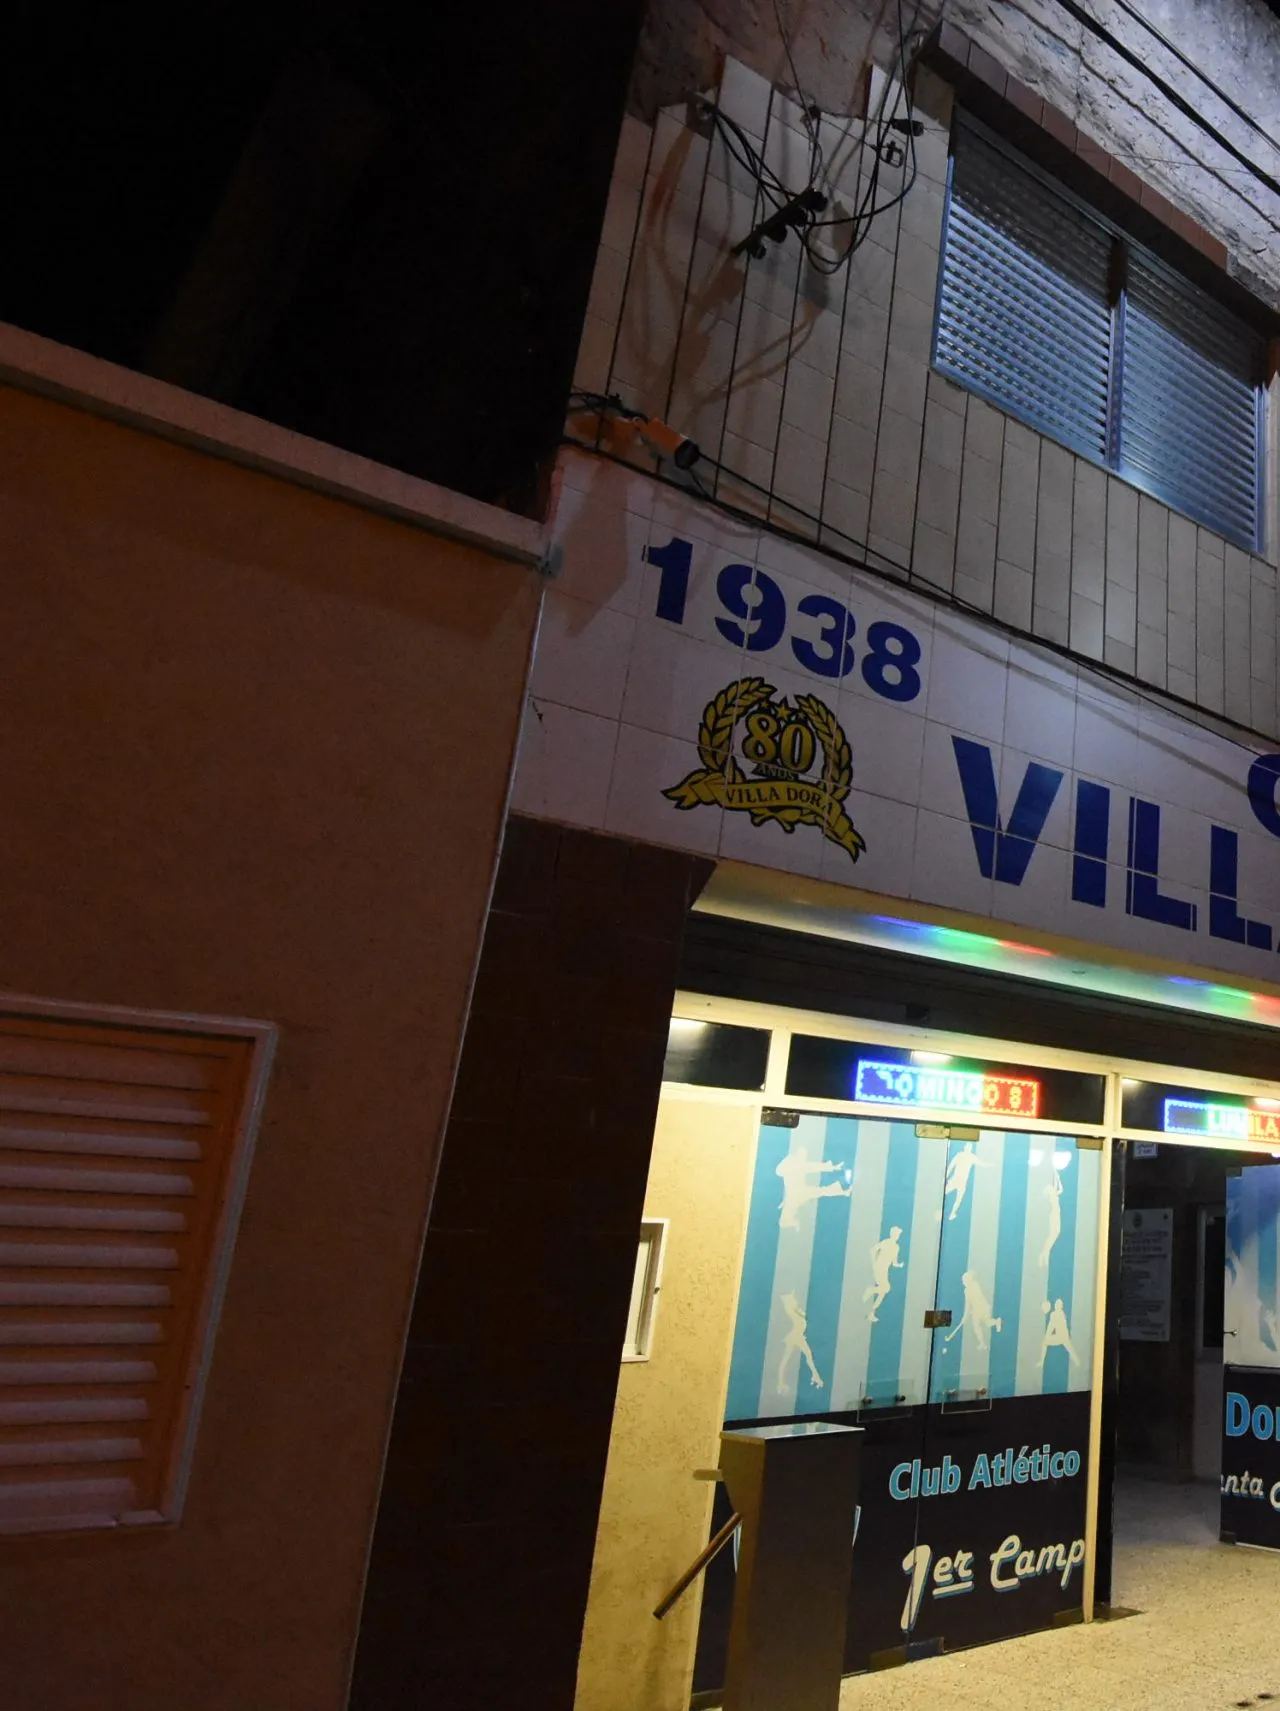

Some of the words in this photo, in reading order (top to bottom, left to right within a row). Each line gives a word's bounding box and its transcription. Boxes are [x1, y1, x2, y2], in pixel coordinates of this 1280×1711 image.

[641, 536, 922, 703] 1938
[742, 708, 817, 775] 80
[725, 786, 781, 804] VILLA
[786, 786, 834, 818] DORA
[1009, 1085, 1022, 1110] 8
[889, 1456, 961, 1501] Club
[967, 1443, 1081, 1491] Atlético
[901, 1544, 975, 1633] 1er
